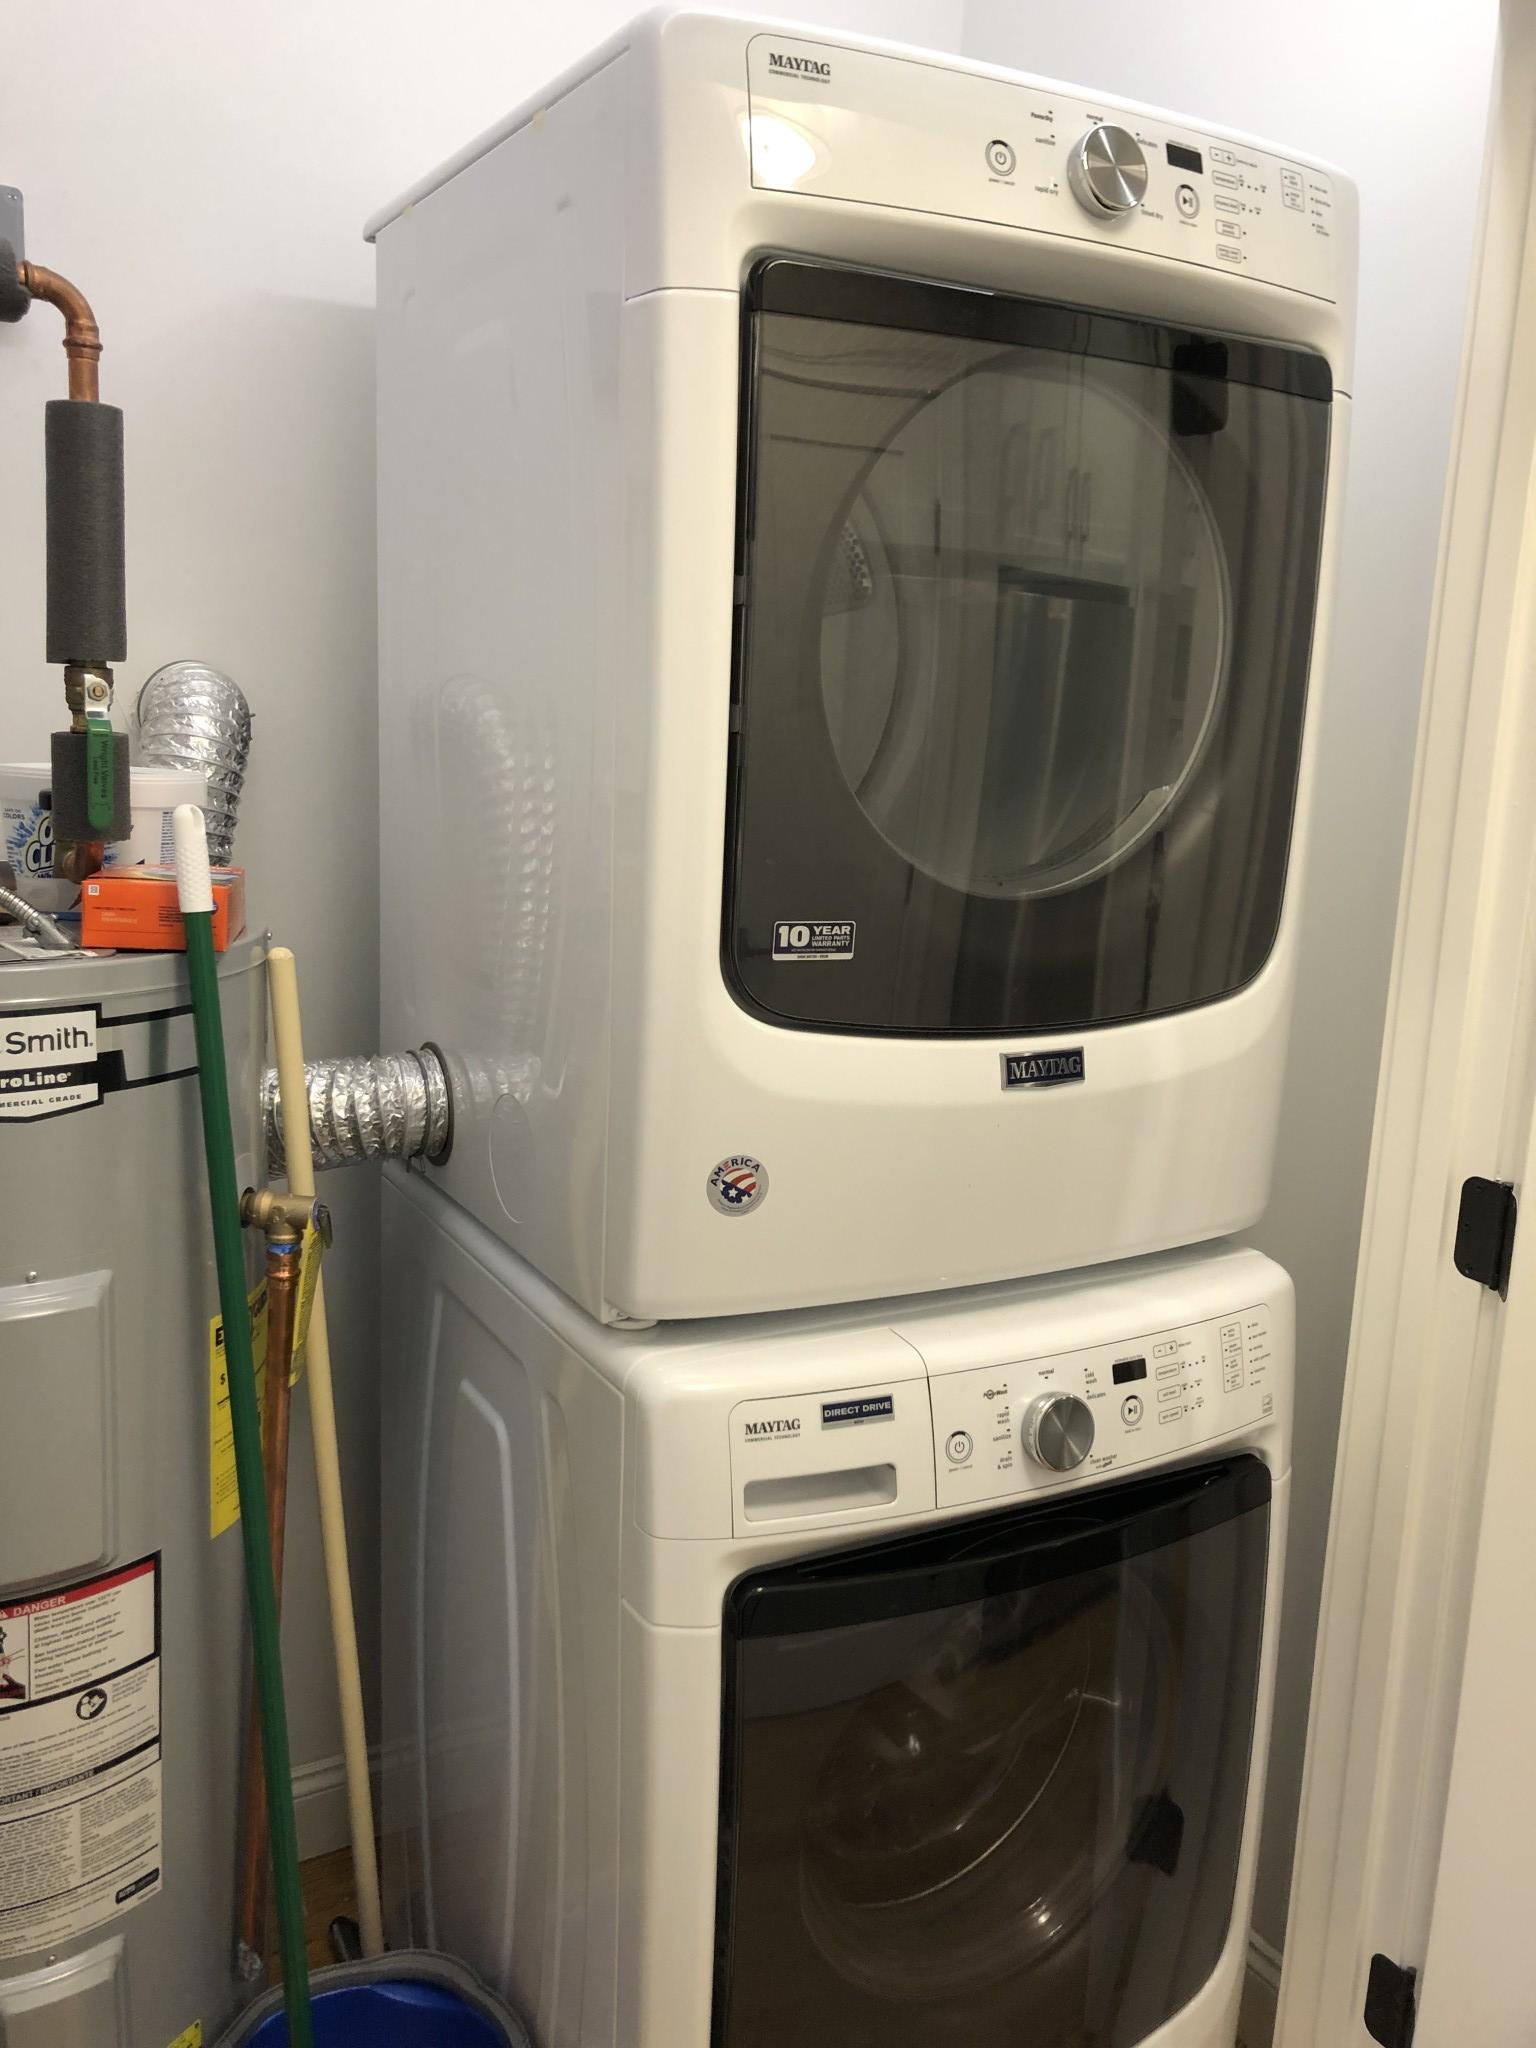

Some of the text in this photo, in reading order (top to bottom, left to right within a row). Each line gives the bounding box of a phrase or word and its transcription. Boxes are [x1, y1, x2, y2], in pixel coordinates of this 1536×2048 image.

[769, 53, 831, 76] MAYTAG
[779, 925, 851, 947] 10 YEAR
[1010, 1056, 1081, 1080] MAYTAG
[0, 1072, 68, 1089] roLine
[0, 1093, 82, 1108] MERCIAL GRADE
[710, 1157, 760, 1187] AMERICA
[824, 1401, 891, 1418] DIRECT DRIVE
[745, 1418, 801, 1436] MAYTAG
[12, 1595, 66, 1617] DANGER
